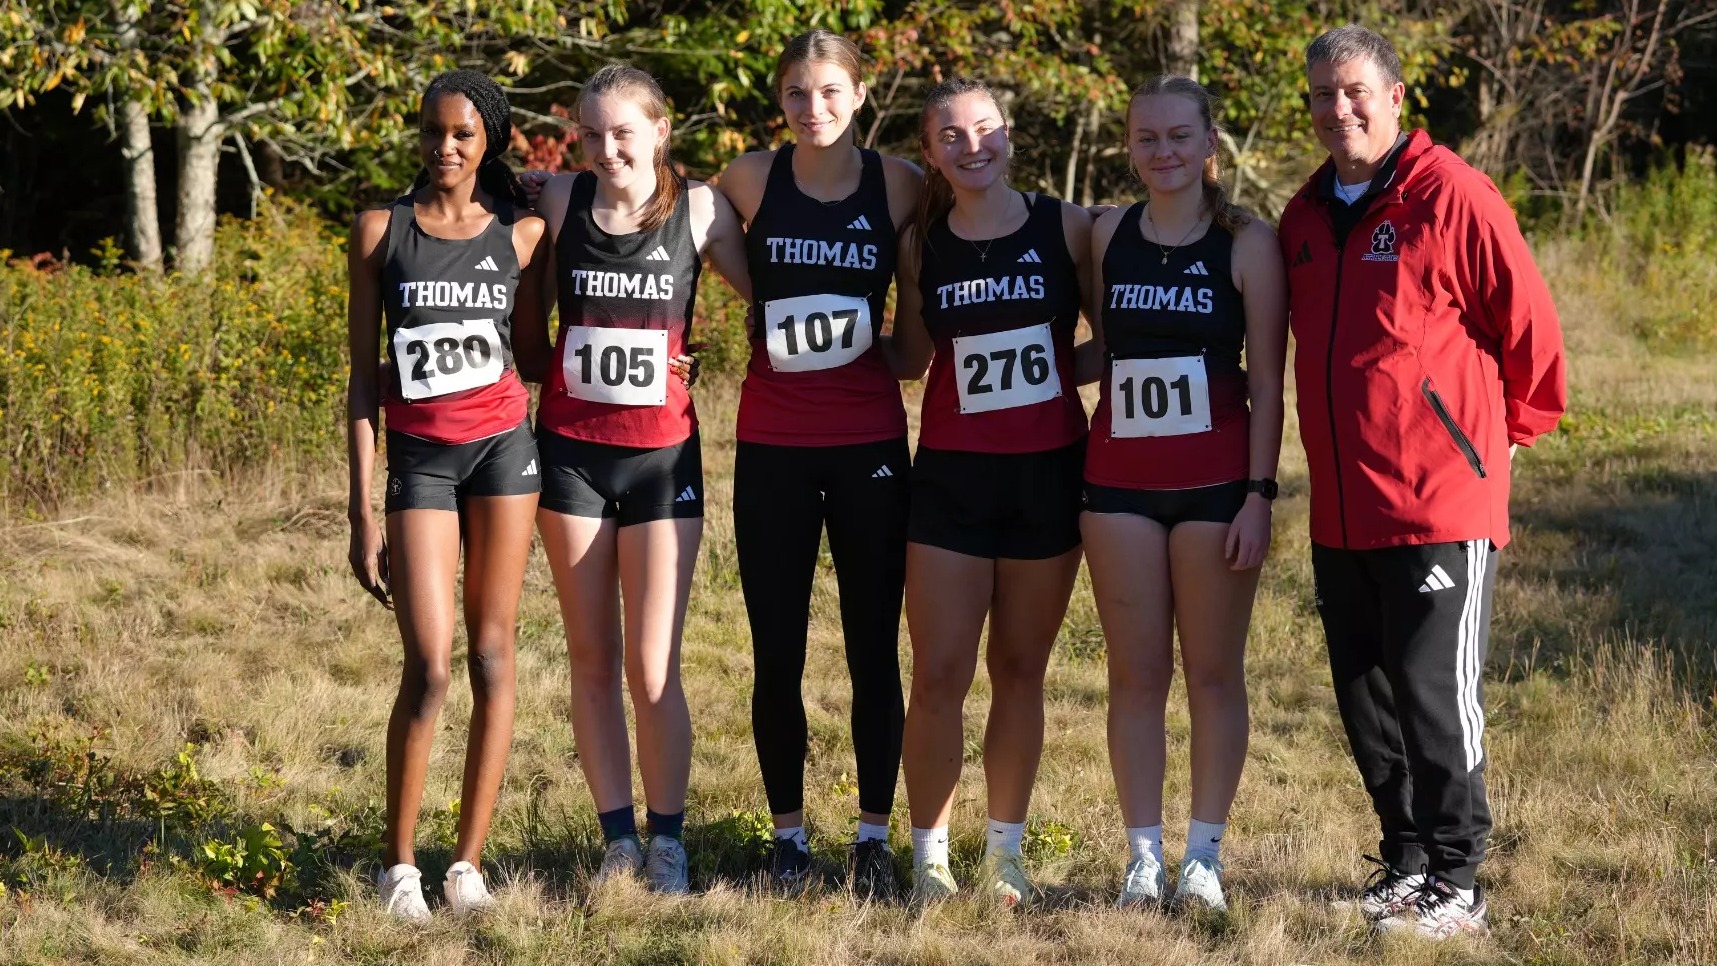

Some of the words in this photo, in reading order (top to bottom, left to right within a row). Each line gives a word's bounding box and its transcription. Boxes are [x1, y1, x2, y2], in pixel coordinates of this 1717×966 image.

[767, 237, 876, 270] THOMAS
[1378, 235, 1389, 249] T
[400, 282, 506, 309] THOMAS
[571, 270, 673, 299] THOMAS
[937, 276, 1044, 309] THOMAS
[1111, 285, 1212, 313] THOMAS
[778, 309, 858, 355] 107
[407, 335, 490, 381] 280
[575, 345, 655, 387] 105
[964, 344, 1049, 395] 276
[1119, 375, 1192, 419] 101
